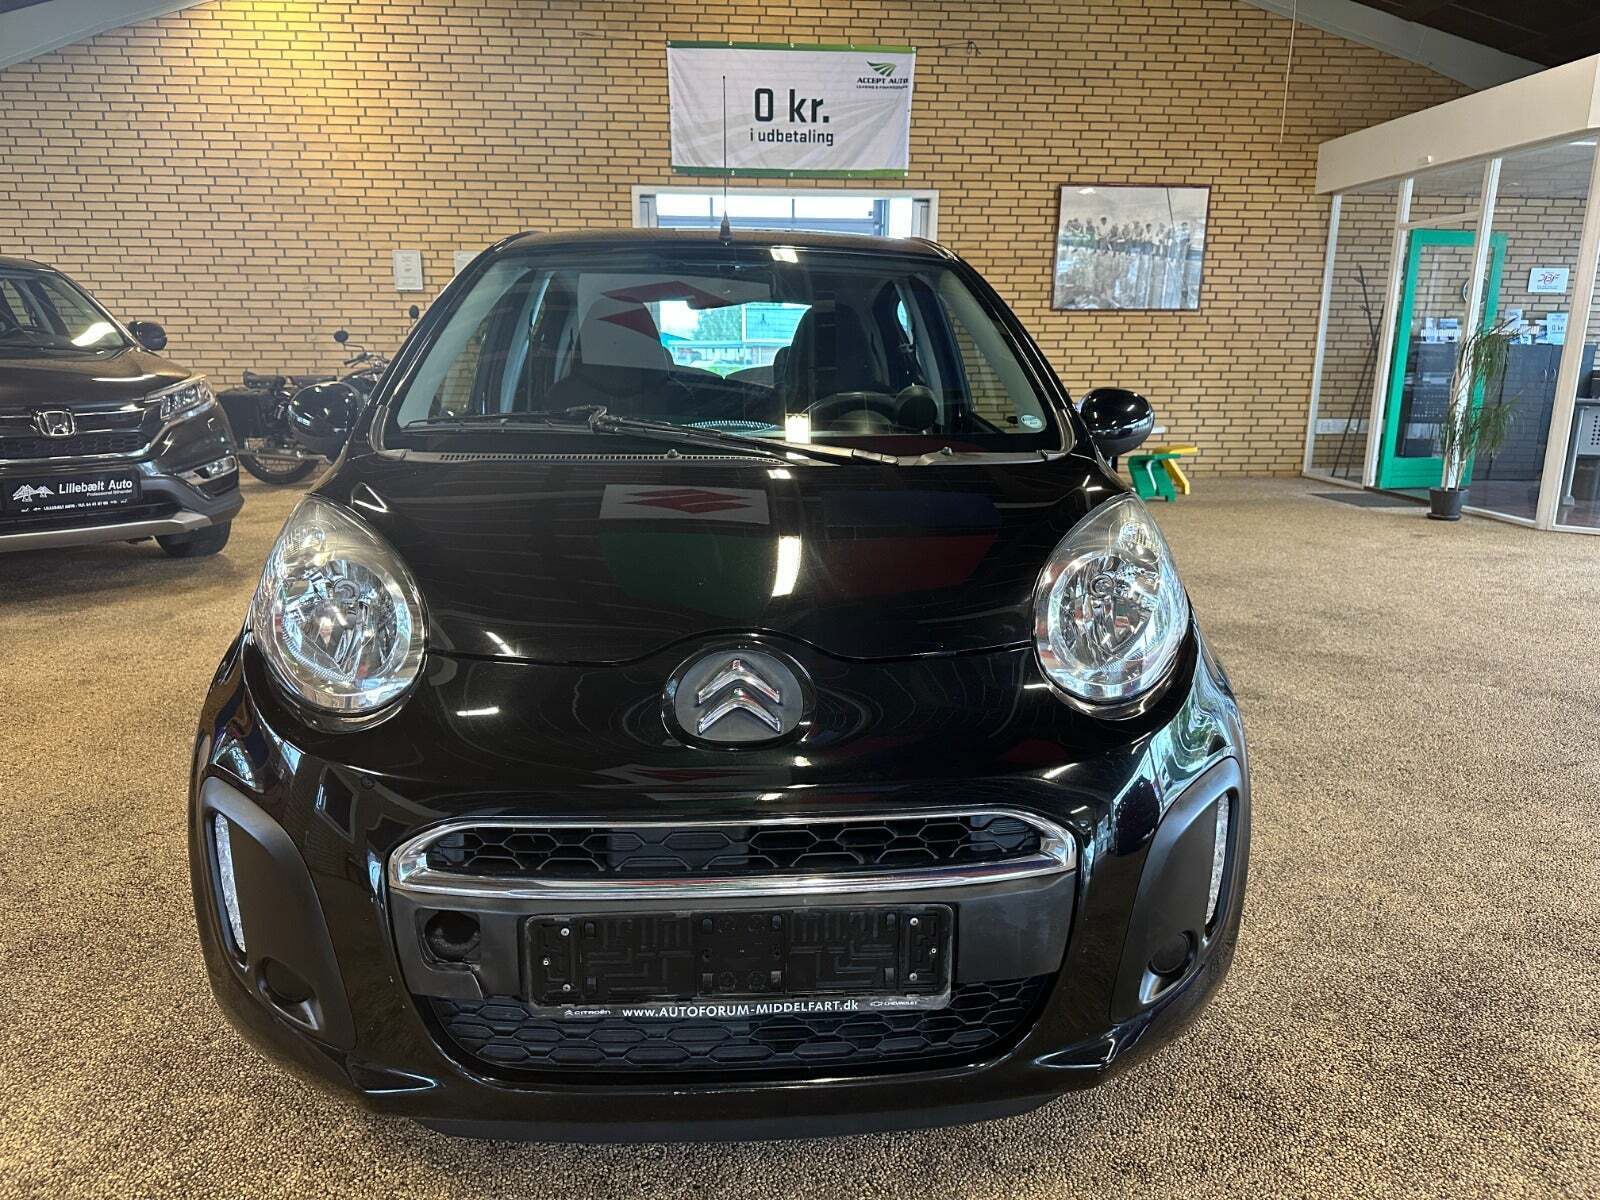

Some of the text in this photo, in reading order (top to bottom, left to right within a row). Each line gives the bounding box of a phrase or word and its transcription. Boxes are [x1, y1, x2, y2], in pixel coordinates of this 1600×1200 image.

[755, 88, 829, 123] 0 kr.
[750, 127, 834, 146] i udbetaling
[59, 481, 104, 494] Lillebælt
[108, 480, 132, 490] Auto
[622, 999, 859, 1018] www.AUTOFORUM-MIDDELFART.dk
